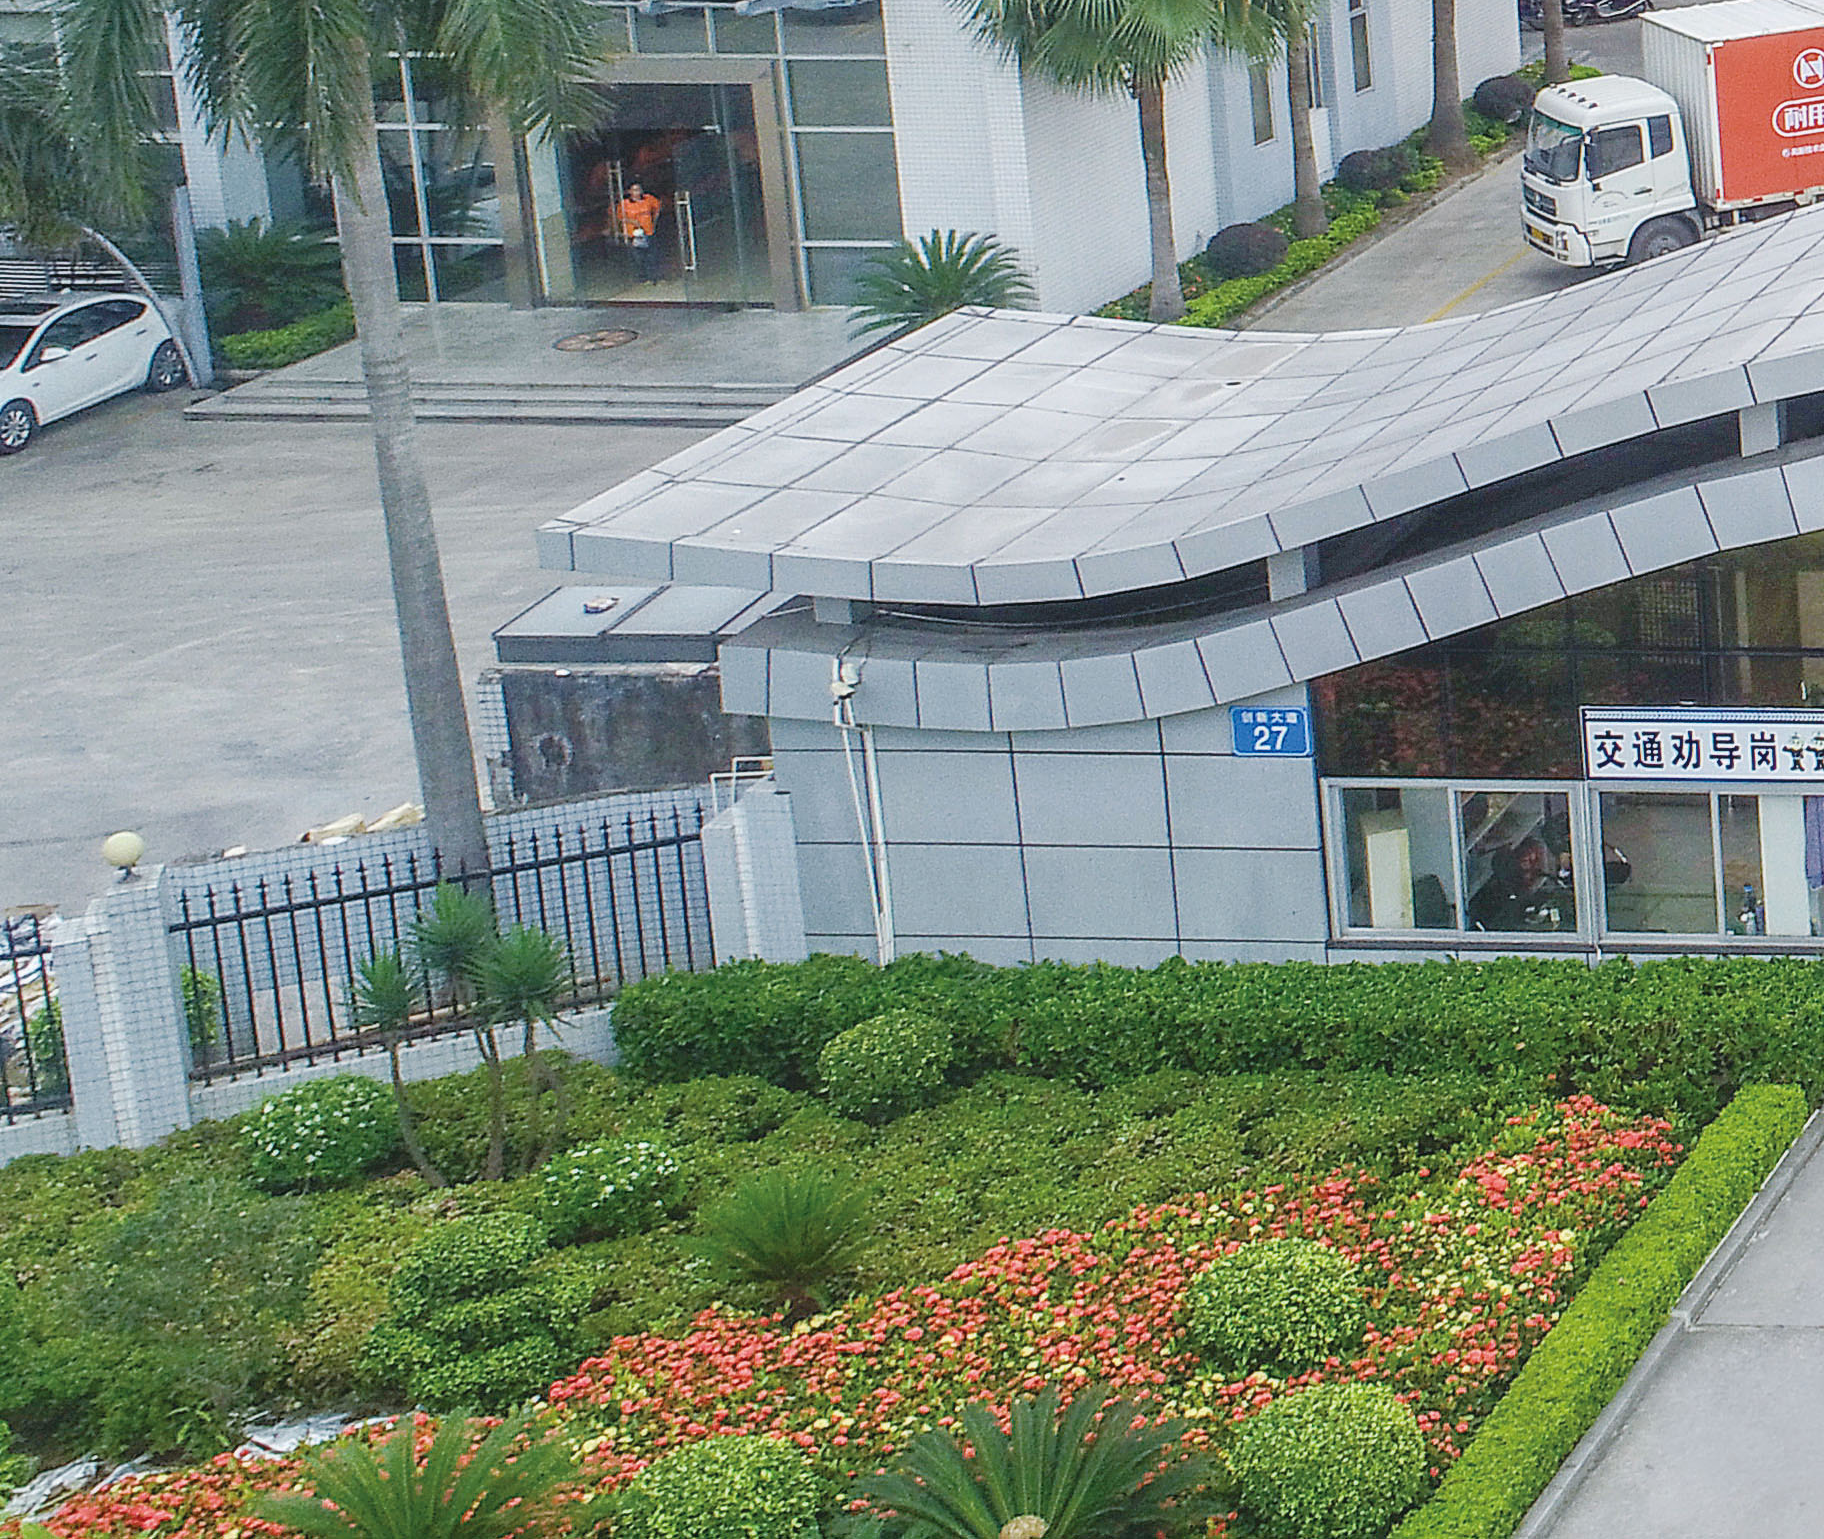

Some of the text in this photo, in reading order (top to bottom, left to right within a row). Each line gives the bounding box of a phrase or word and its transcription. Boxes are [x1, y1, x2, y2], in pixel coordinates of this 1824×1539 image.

[1253, 725, 1289, 751] 27
[1593, 730, 1778, 772] 交通劝导岗
